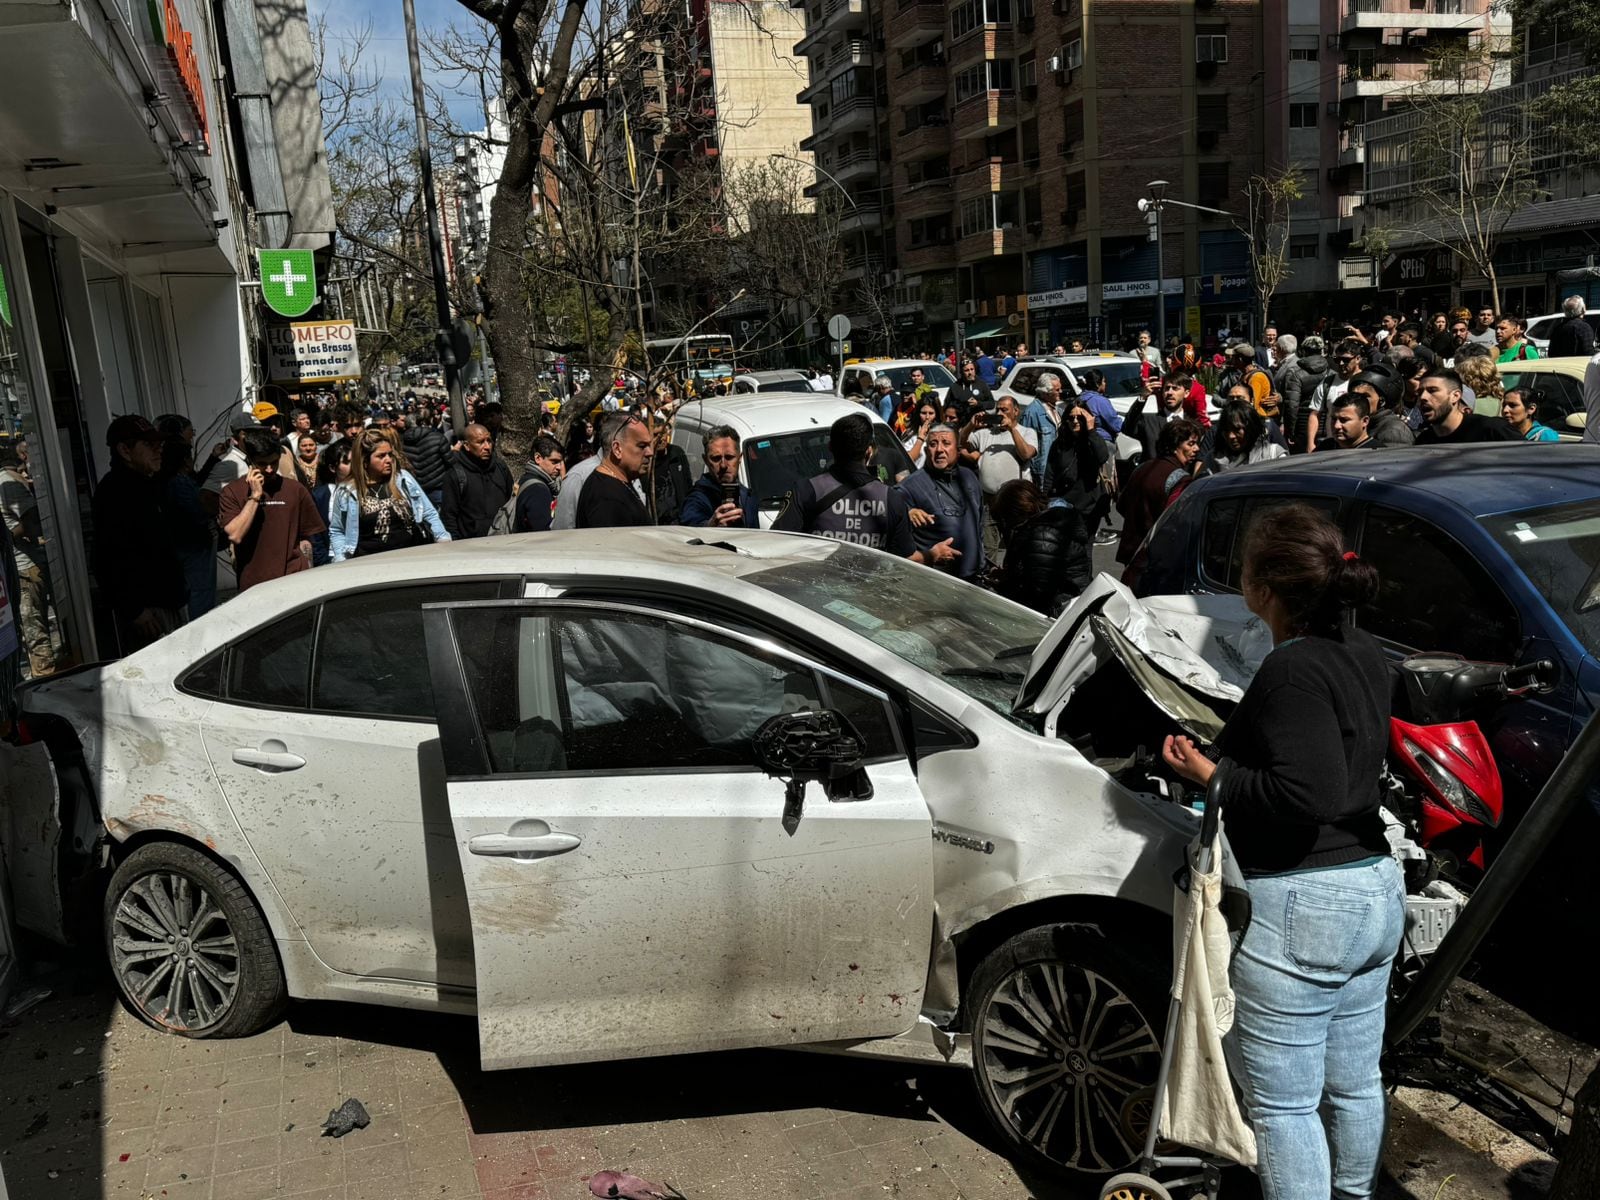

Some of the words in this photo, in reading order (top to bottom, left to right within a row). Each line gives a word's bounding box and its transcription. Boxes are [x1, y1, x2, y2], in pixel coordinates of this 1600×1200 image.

[1104, 285, 1126, 293] SAUL
[1029, 294, 1045, 303] SAUL
[268, 326, 352, 343] HOMERO
[272, 344, 296, 355] Pollo
[307, 343, 321, 354] las
[322, 342, 353, 353] Brasas
[280, 356, 348, 367] Empanadas
[291, 369, 340, 378] Lomitos
[831, 498, 887, 518] OLICIA
[845, 518, 862, 530] DE
